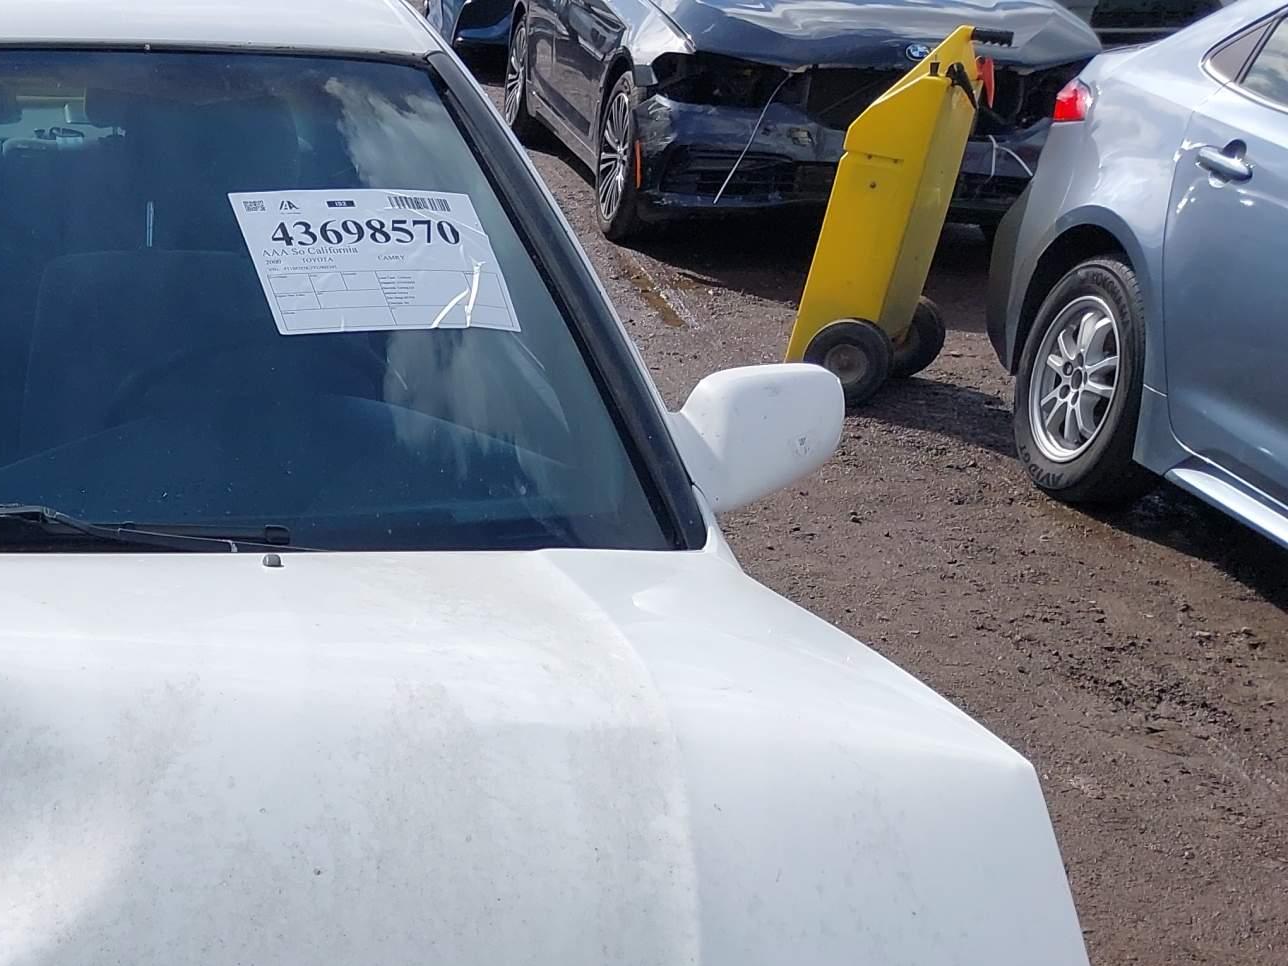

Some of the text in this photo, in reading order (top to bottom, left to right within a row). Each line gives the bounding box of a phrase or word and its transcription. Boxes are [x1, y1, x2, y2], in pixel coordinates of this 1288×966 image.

[272, 219, 460, 246] 43698570
[262, 246, 359, 258] AAA So California
[302, 256, 335, 264] TOYOTA
